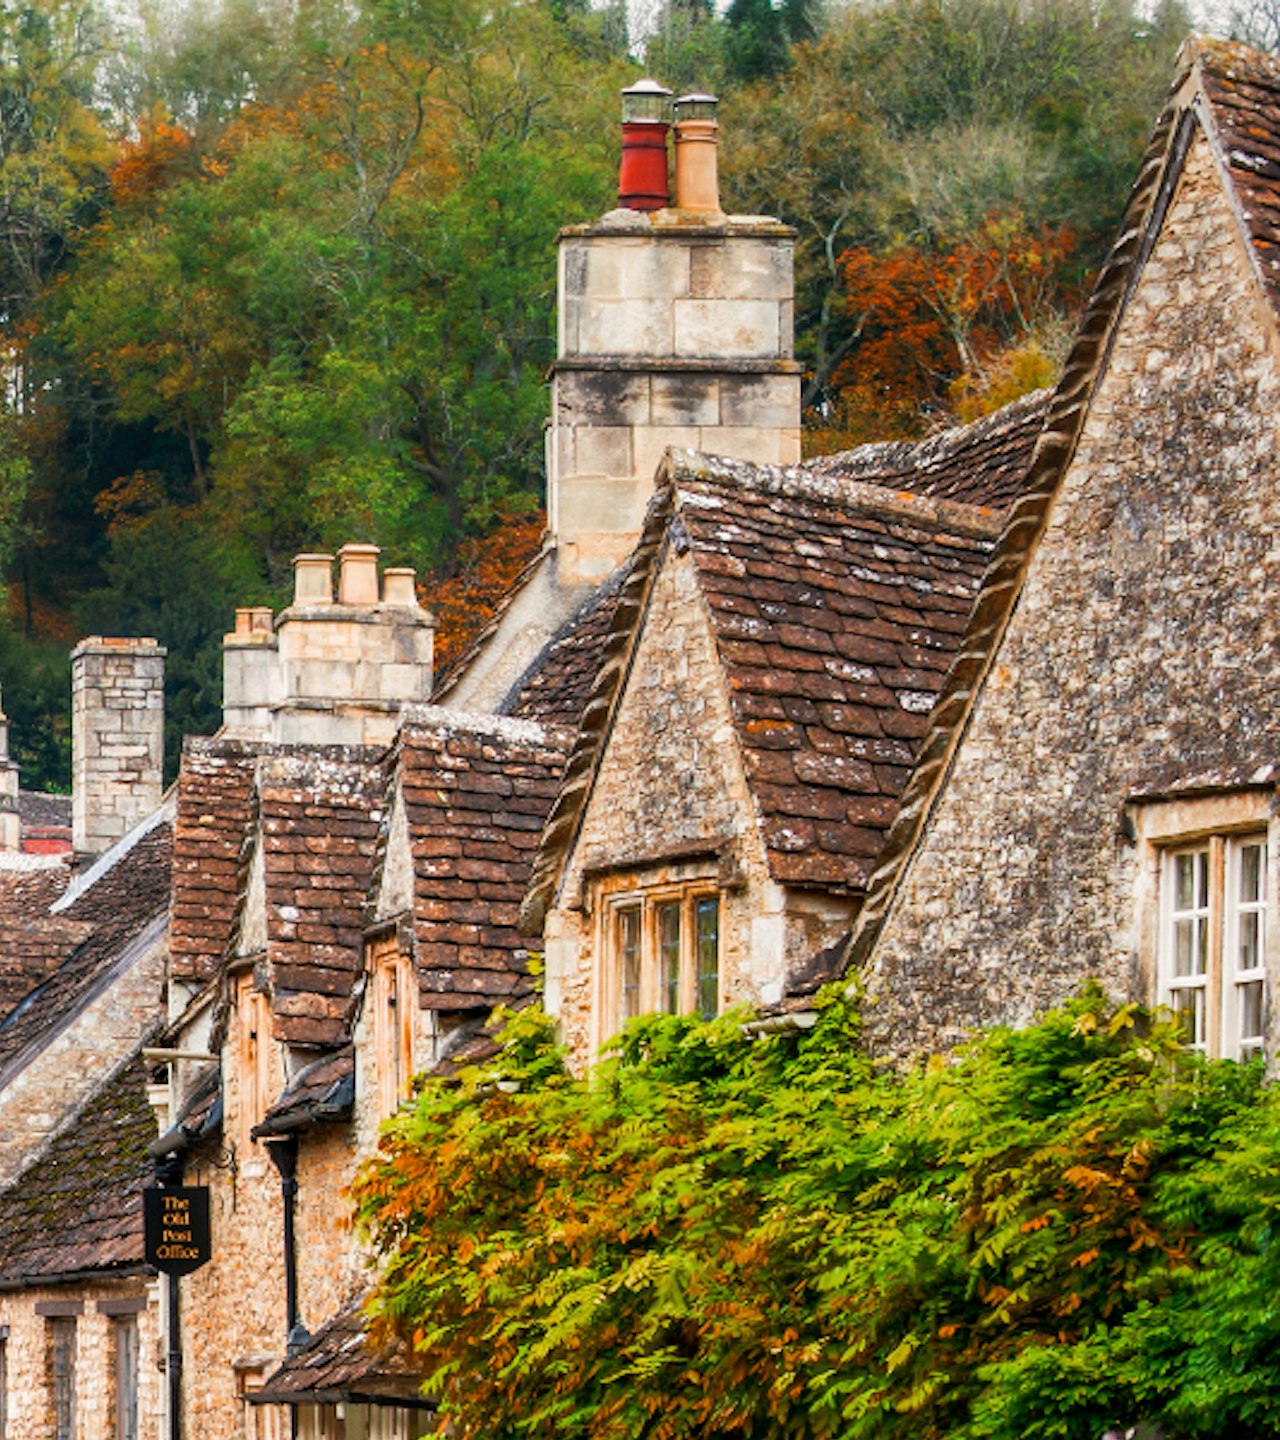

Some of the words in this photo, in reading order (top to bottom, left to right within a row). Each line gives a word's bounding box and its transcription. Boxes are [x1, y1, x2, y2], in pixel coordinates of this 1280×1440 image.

[161, 1196, 190, 1210] The
[163, 1211, 190, 1226] Old
[163, 1229, 192, 1242] Post
[156, 1244, 199, 1259] Office
